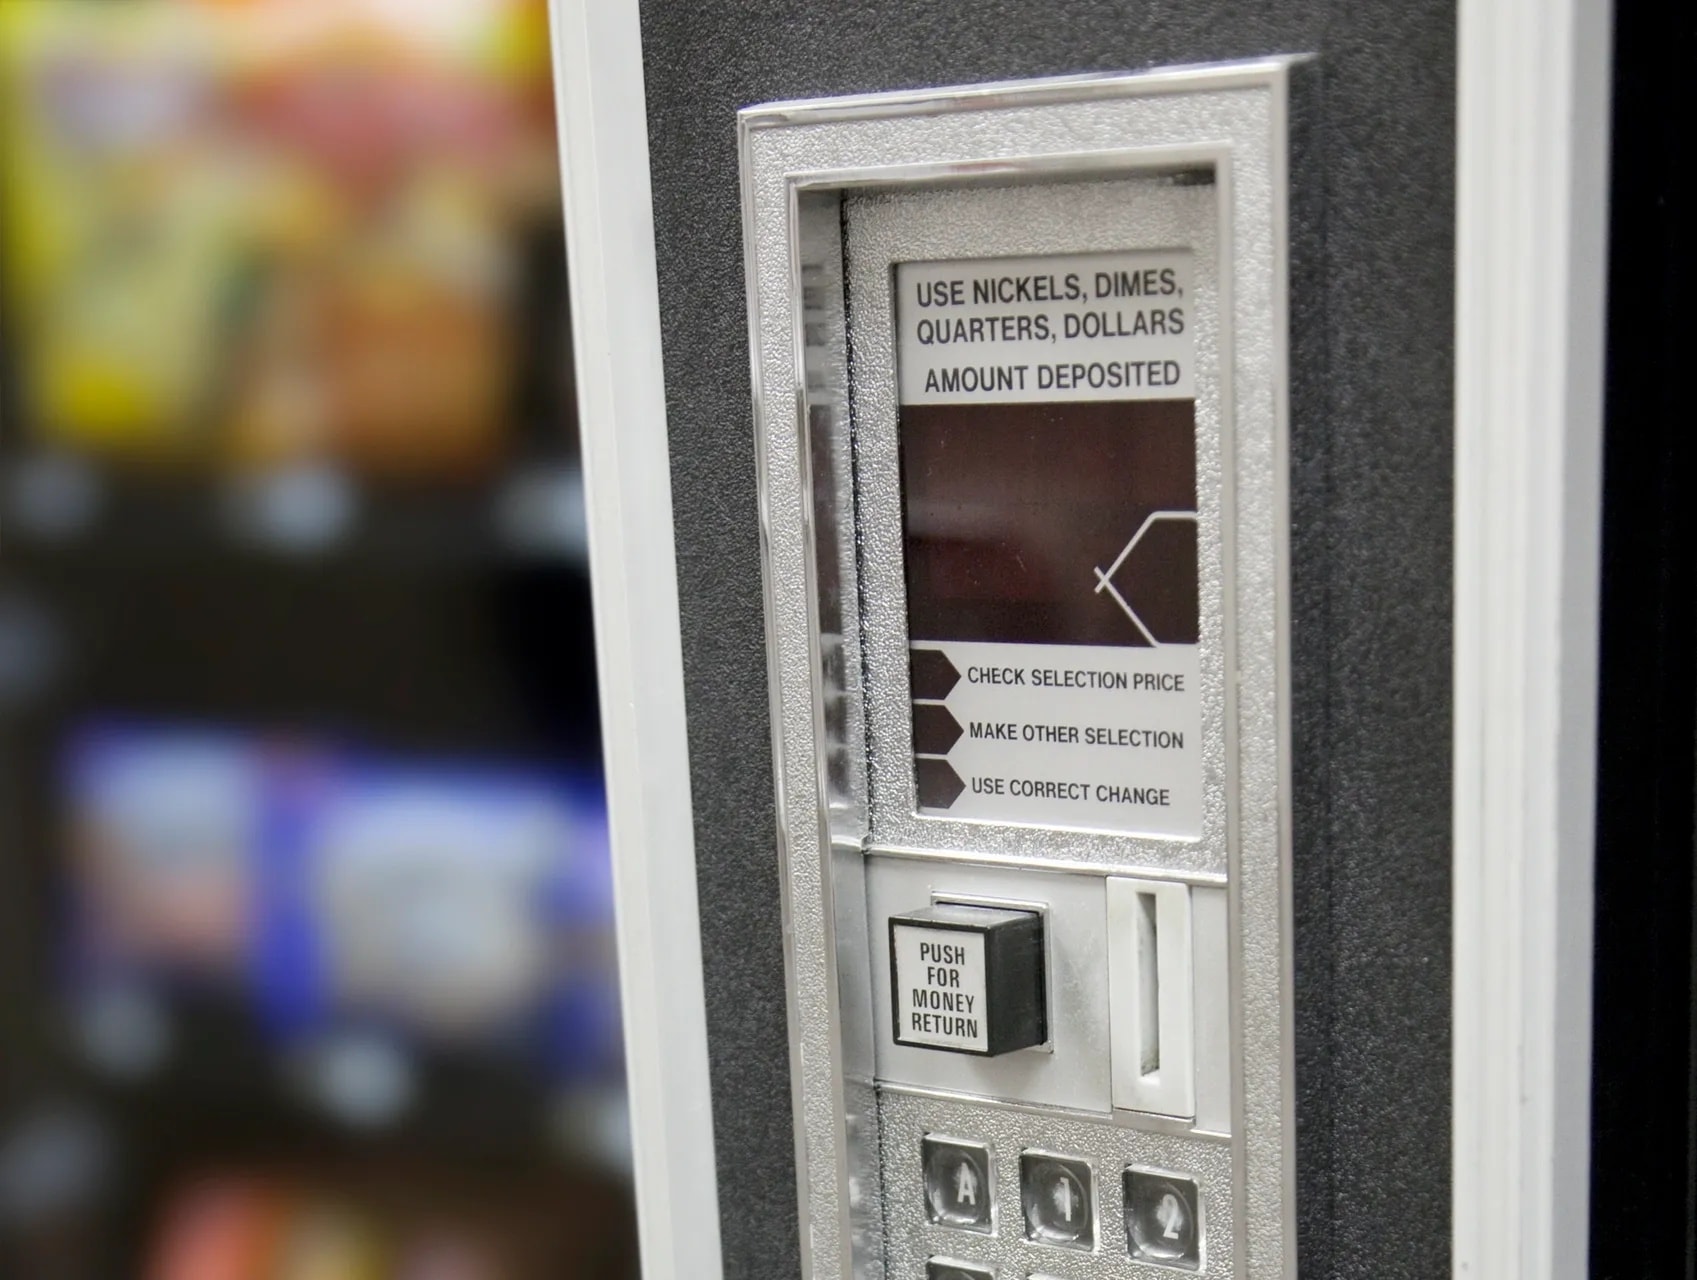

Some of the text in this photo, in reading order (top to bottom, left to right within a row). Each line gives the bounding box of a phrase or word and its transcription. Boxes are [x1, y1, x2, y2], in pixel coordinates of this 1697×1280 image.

[916, 267, 1184, 308] USE NICKELS, DIMES,
[916, 308, 1185, 345] QUARTERS, DOLLARS
[924, 360, 1181, 393] AMOUNT DEPOSITED
[967, 666, 1185, 692] CHECK SELECTION PRICE
[969, 722, 1184, 750] MAKE OTHER SELECTION
[972, 777, 1171, 806] USE CORRECT CHANGE
[919, 942, 966, 966] PUSH
[926, 965, 960, 988] FOR
[912, 989, 976, 1015] MONEY
[911, 1013, 978, 1039] RETURN
[957, 1162, 976, 1205] A
[1059, 1177, 1072, 1222] 1
[1161, 1194, 1181, 1240] 2
